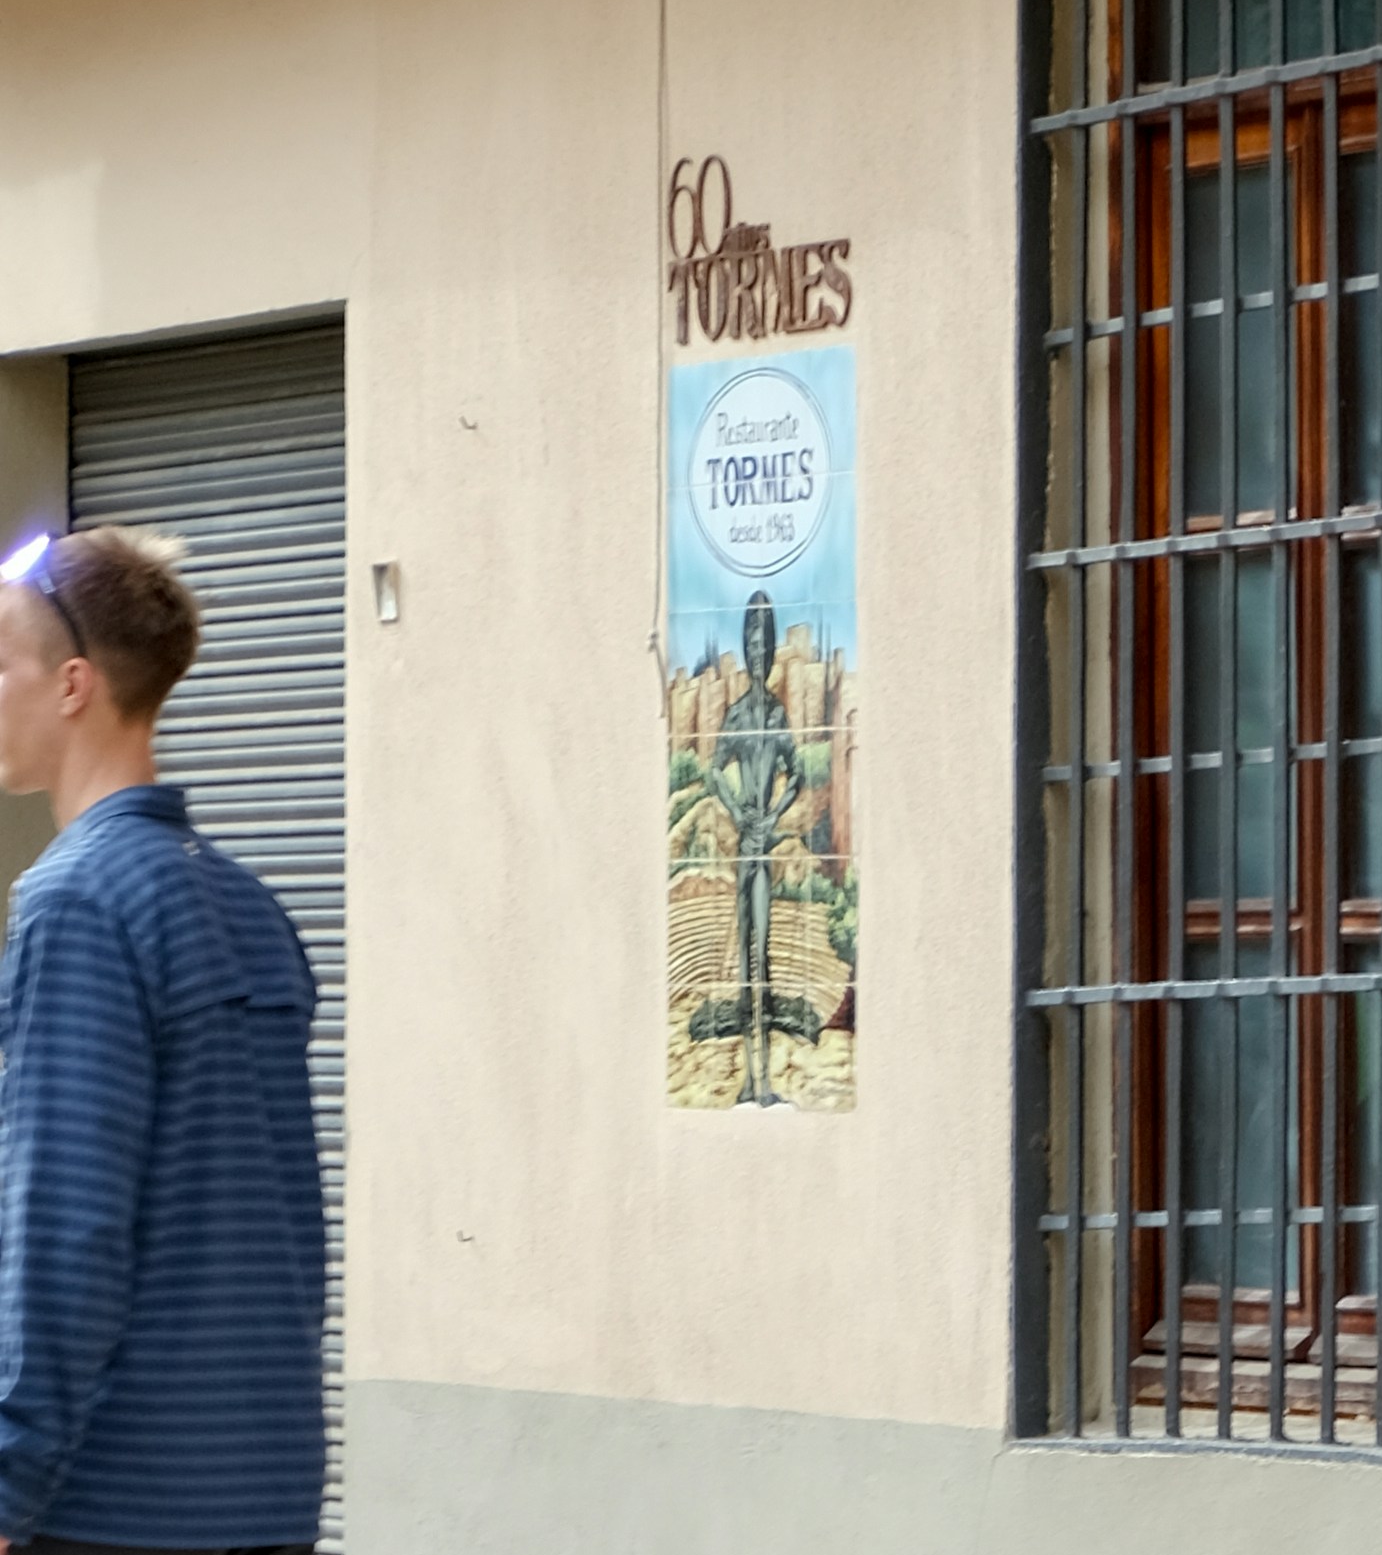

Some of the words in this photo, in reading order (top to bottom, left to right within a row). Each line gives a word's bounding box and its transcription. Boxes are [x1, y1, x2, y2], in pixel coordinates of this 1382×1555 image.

[669, 154, 733, 260] 60
[667, 238, 853, 346] TORMES
[716, 411, 799, 448] Restaurante
[706, 448, 814, 510] TORMES
[728, 520, 764, 545] desde
